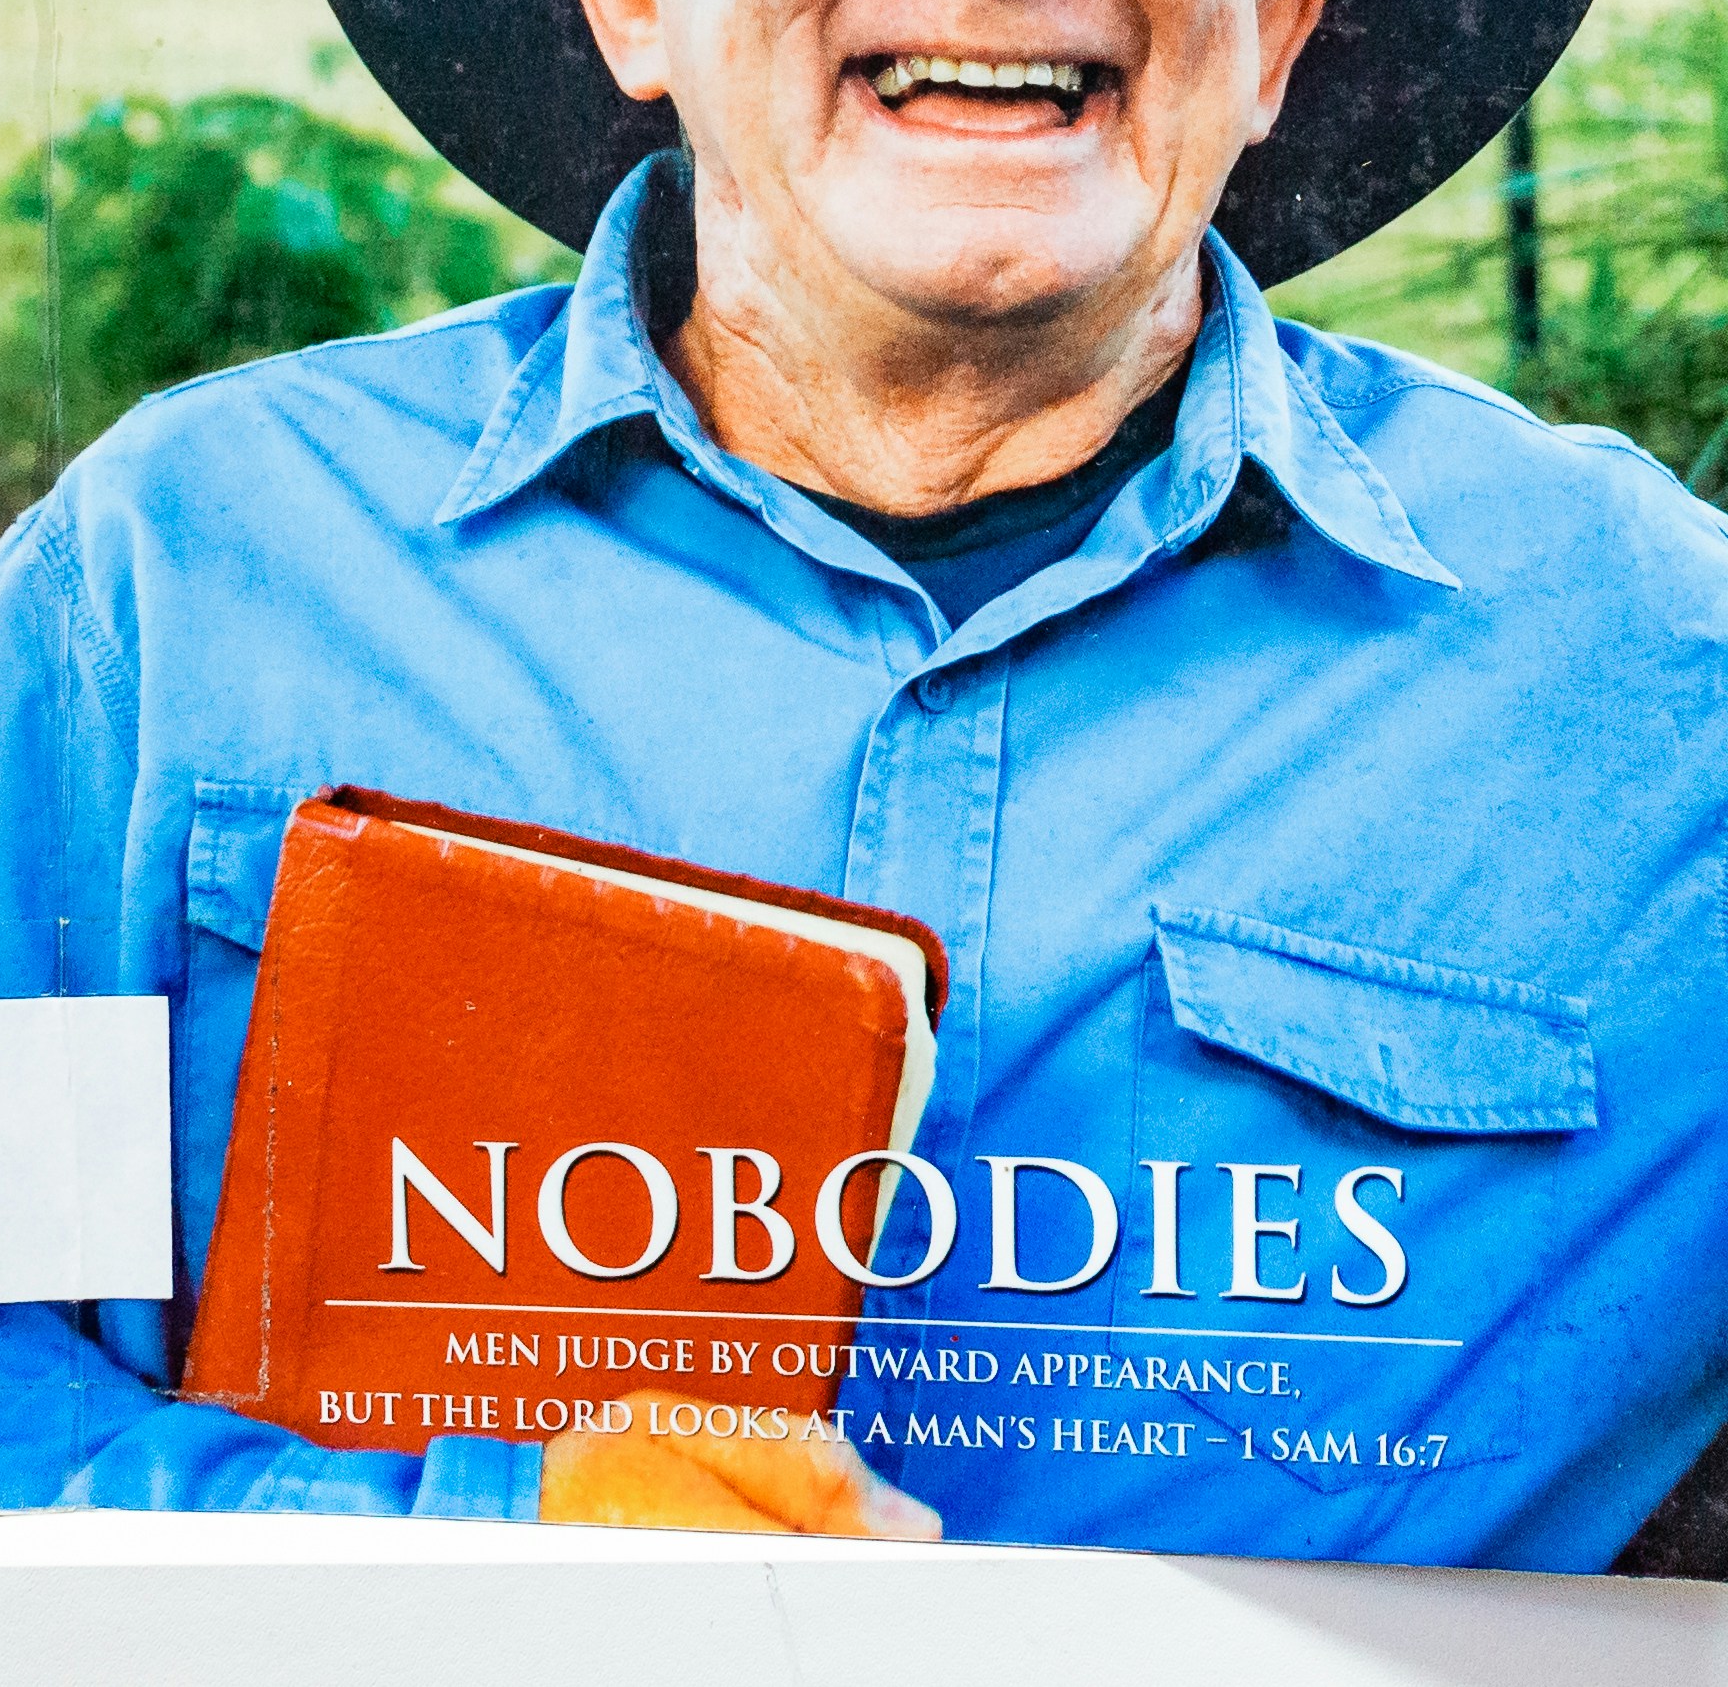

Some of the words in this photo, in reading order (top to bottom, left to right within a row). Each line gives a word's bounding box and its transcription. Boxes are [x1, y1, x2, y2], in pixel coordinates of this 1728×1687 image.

[376, 1137, 1410, 1310] NOBODIES
[445, 1332, 539, 1368] MEN
[555, 1335, 695, 1377] JUDGE
[710, 1341, 760, 1374] BY
[771, 1343, 999, 1384] OUTWARD
[1010, 1353, 1303, 1399] APPEARANCE,
[318, 1390, 402, 1426] BUT
[413, 1394, 500, 1428] THE
[515, 1397, 633, 1434] LORD
[649, 1402, 789, 1440] LOOKS
[801, 1408, 854, 1442] AT
[864, 1410, 894, 1444] A
[1053, 1418, 1195, 1457] HEART
[1240, 1428, 1254, 1460] 1
[1272, 1428, 1360, 1465] SAM
[1375, 1433, 1449, 1469] 16:7
